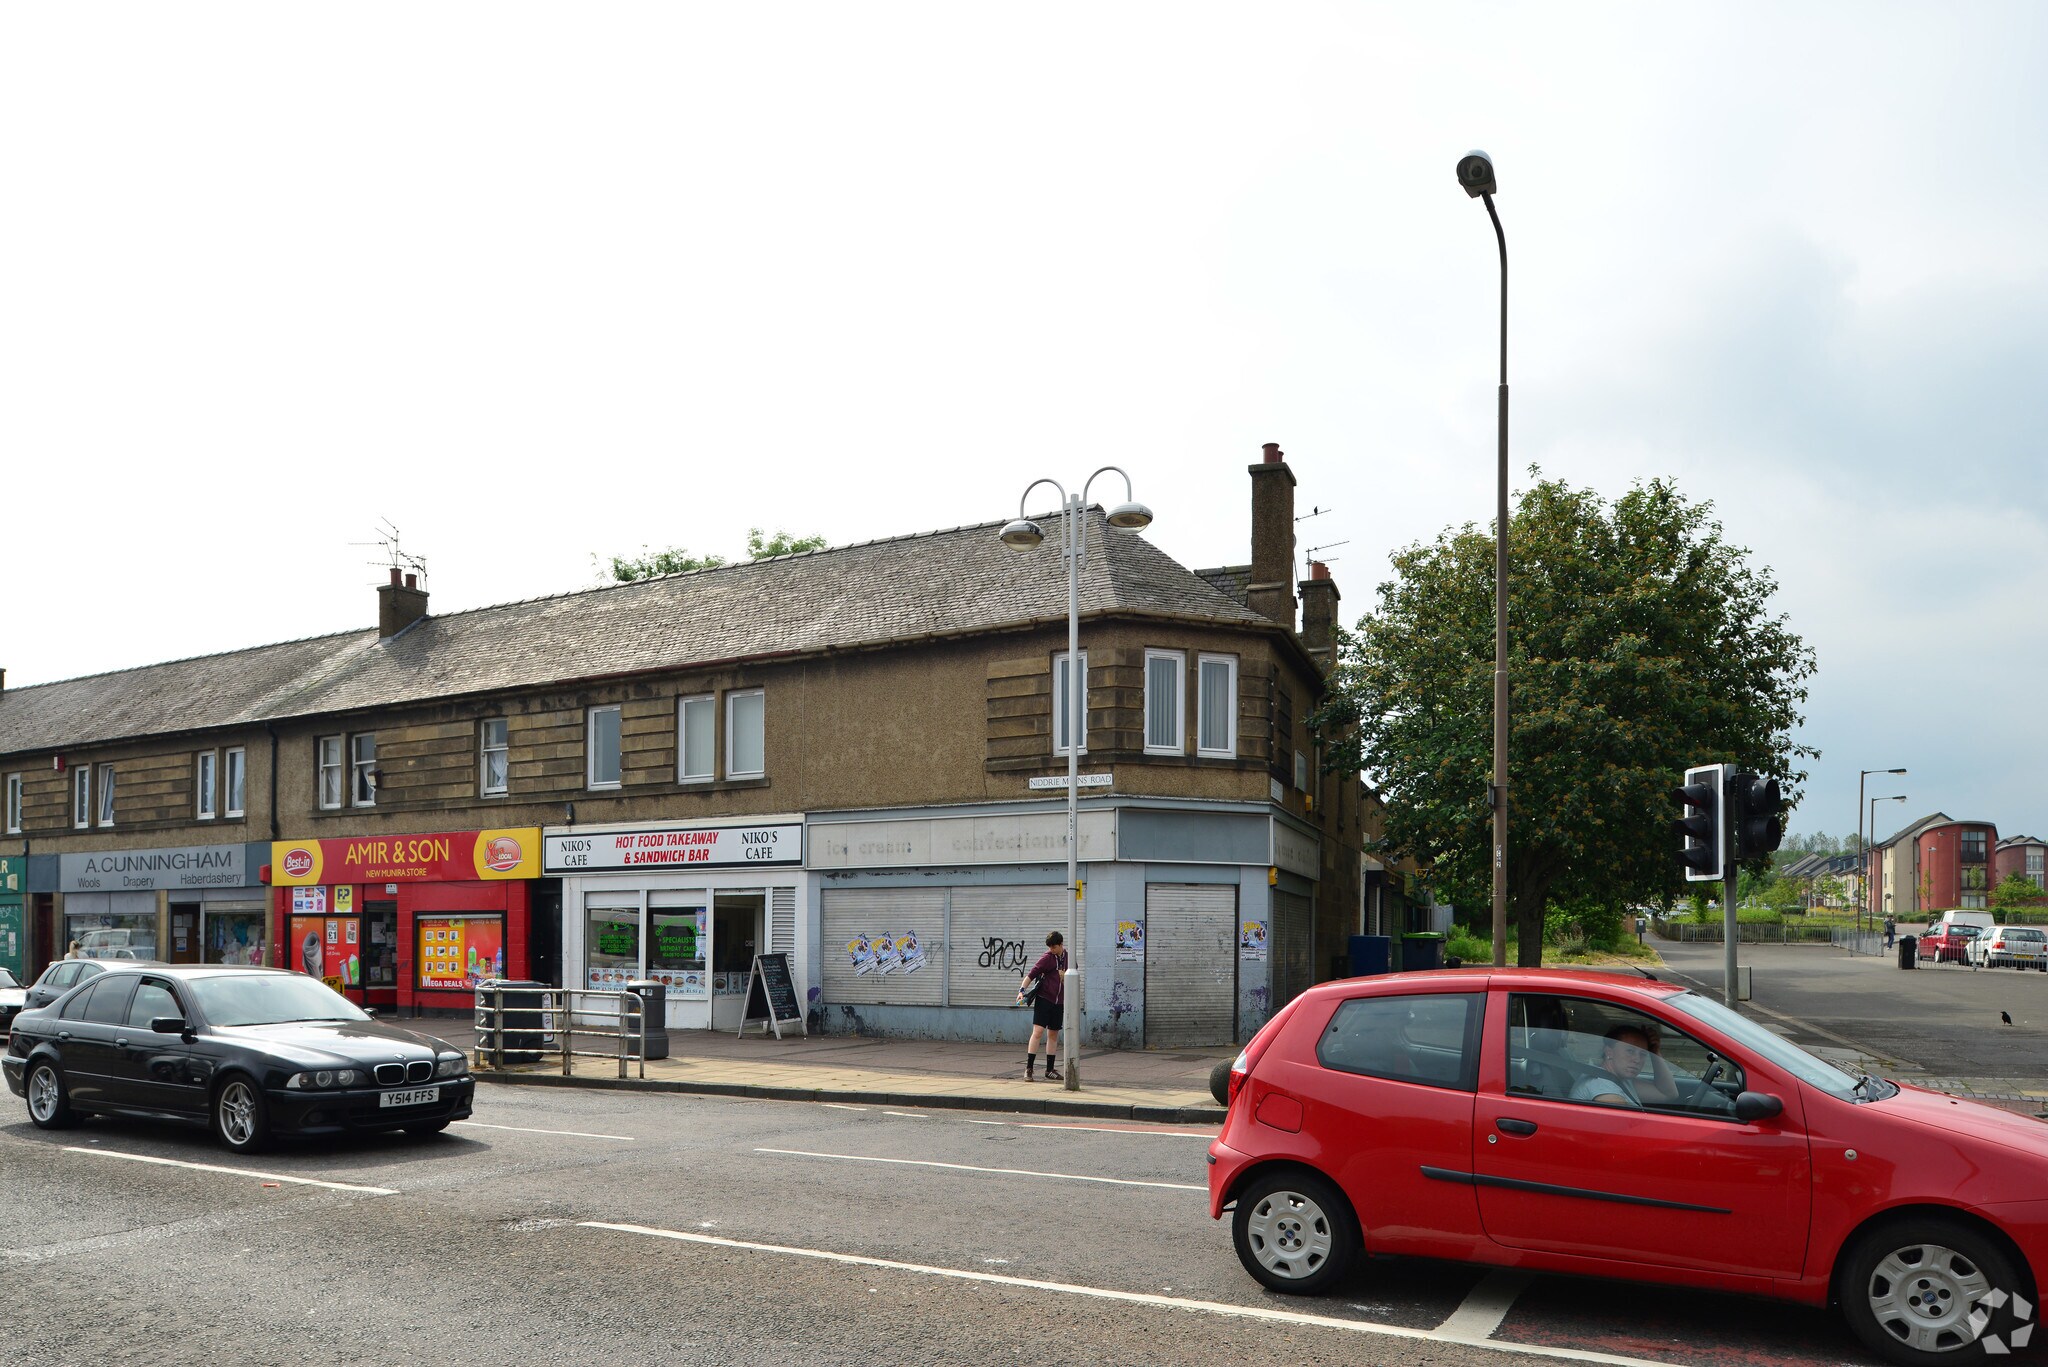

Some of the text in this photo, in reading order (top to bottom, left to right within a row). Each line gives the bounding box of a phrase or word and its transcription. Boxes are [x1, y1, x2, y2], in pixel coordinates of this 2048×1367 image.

[1030, 775, 1112, 787] NIDDRIE MNS ROAD
[615, 832, 719, 848] HOT FOOD TAKEAWAY
[741, 831, 778, 844] NIKO'S
[345, 839, 449, 865] AMIR & SON
[560, 840, 592, 852] NIKO'S
[564, 854, 588, 866] CAFE
[624, 849, 709, 864] & SANDWICH BAR
[745, 847, 773, 860] CAFE
[85, 851, 232, 873] A.CUNNINGHAM
[180, 872, 242, 886] Haberdashery
[366, 868, 427, 878] NEW MUNIRA STORE
[77, 877, 100, 888] Wools
[123, 876, 155, 889] Drapery
[662, 936, 696, 944] SPECIALISTS
[387, 1090, 434, 1105] Y514 FFS
